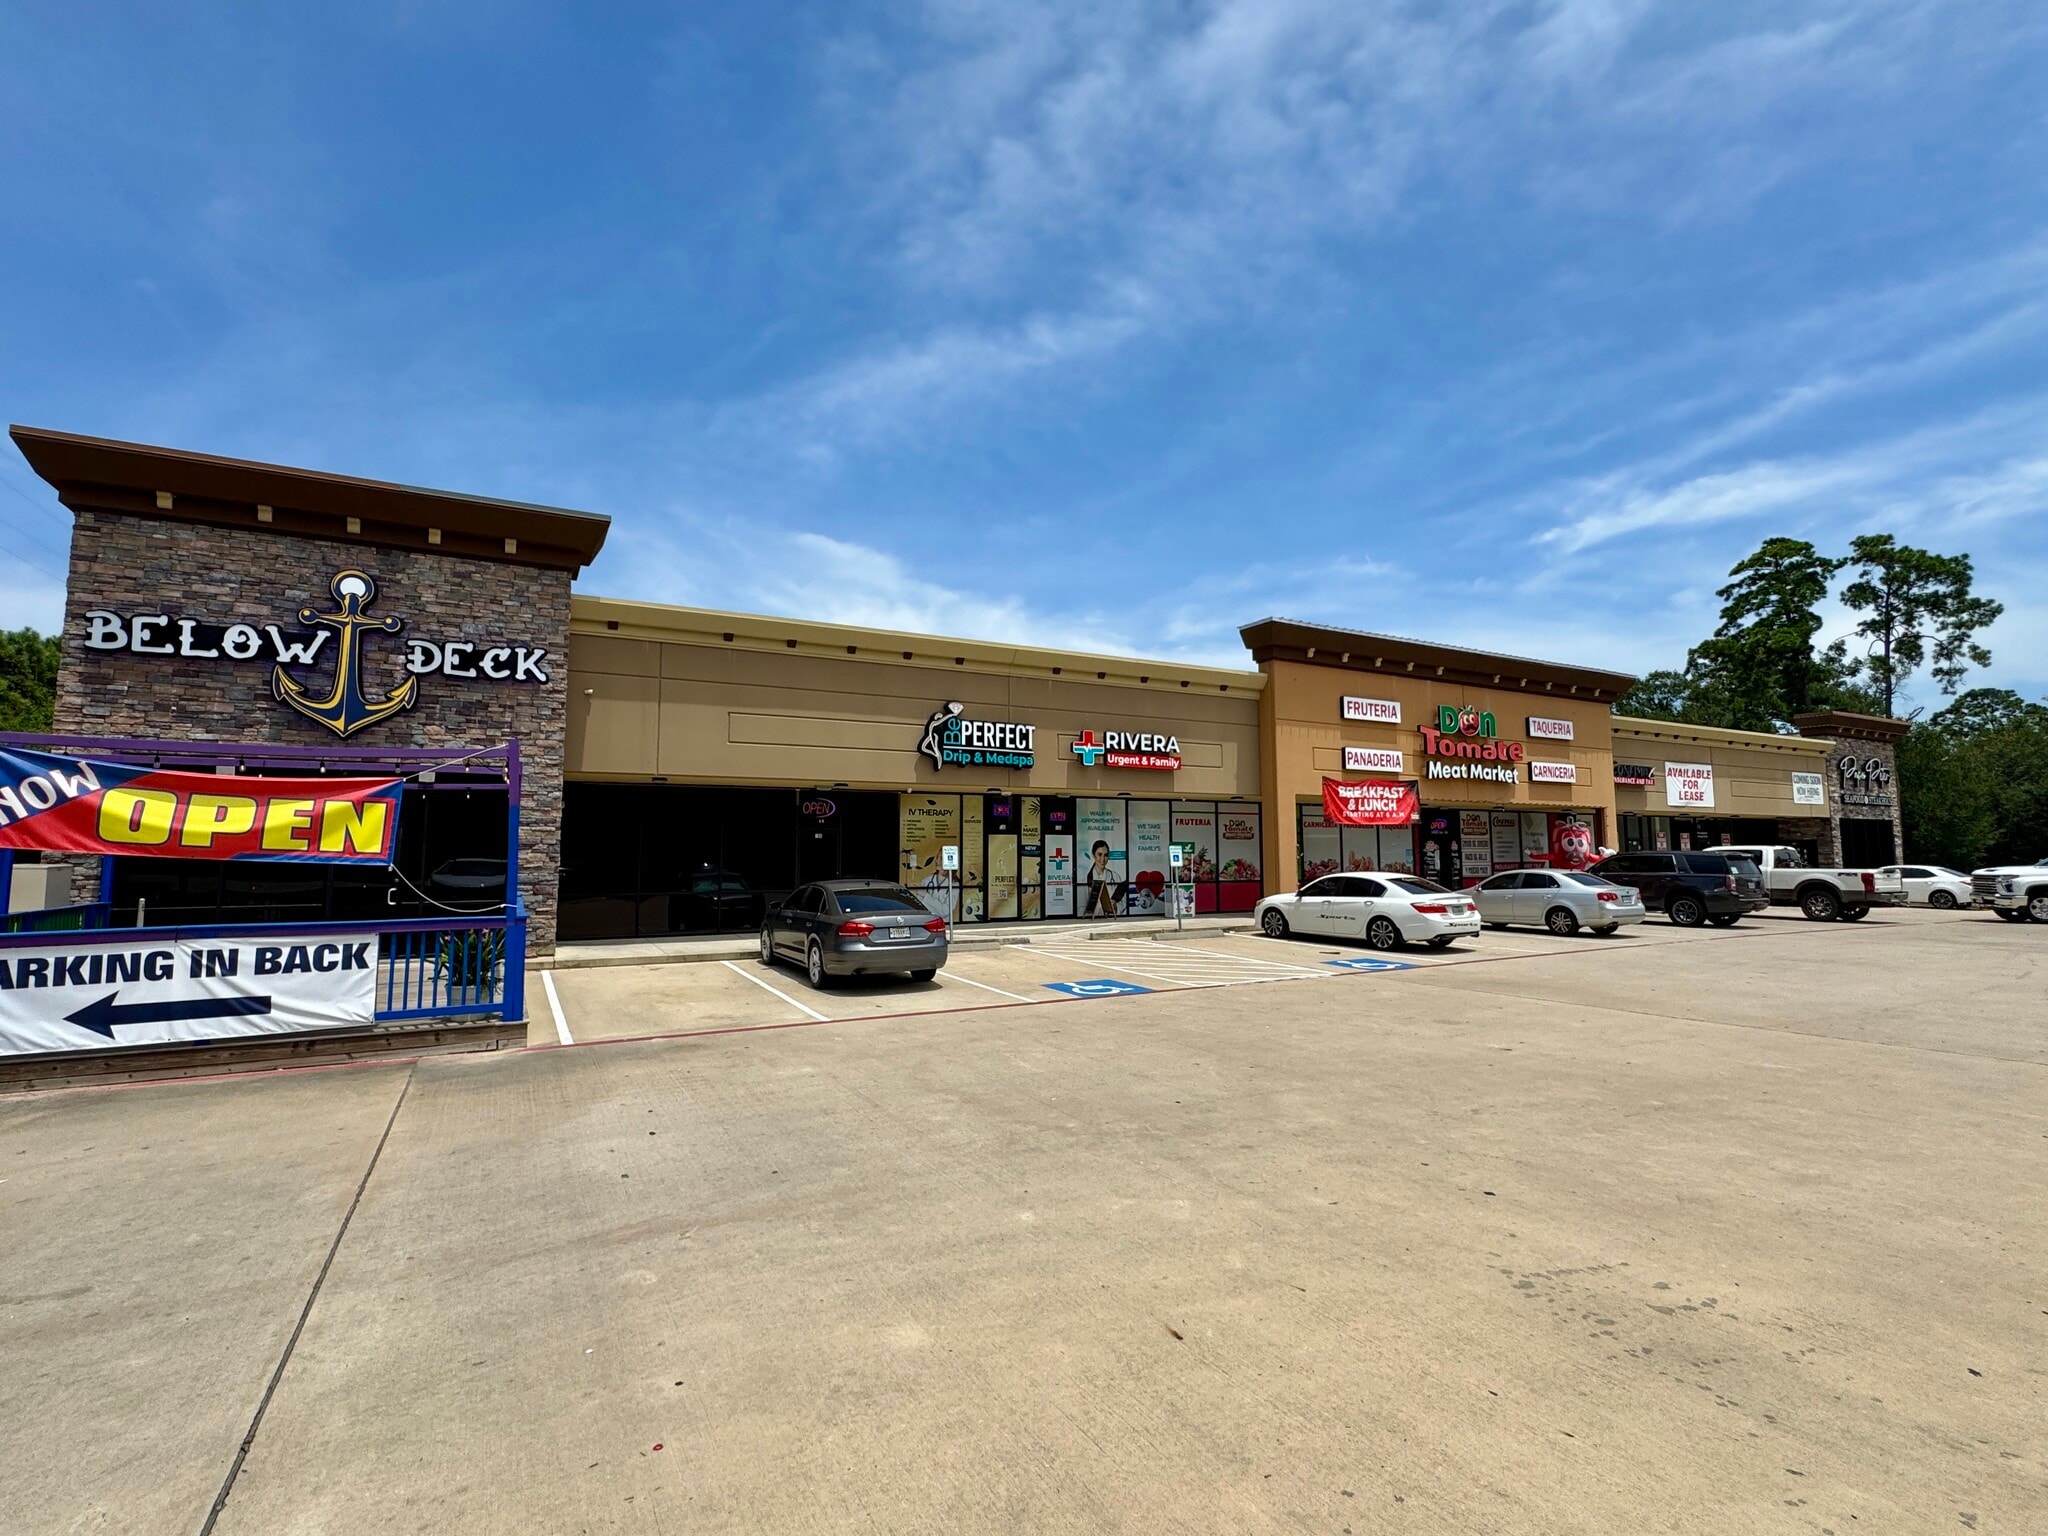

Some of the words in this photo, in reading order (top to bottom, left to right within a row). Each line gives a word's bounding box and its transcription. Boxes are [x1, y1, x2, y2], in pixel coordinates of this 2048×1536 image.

[84, 610, 331, 665] BELOW
[406, 638, 549, 684] DECK
[1347, 701, 1398, 719] FRUTERIA
[1438, 704, 1496, 737] Don
[1532, 720, 1571, 736] TAQUERIA
[943, 718, 961, 745] Be
[961, 720, 1036, 750] PERFECT
[1106, 731, 1181, 753] RIVERA
[1419, 725, 1524, 761] Tomate
[943, 750, 971, 765] Drip
[974, 752, 983, 763] &
[986, 752, 1034, 768] Medspa
[1107, 754, 1139, 766] Urgent
[1141, 757, 1148, 765] &
[1150, 757, 1180, 769] Family
[1347, 751, 1402, 769] PANADERIA
[1428, 760, 1468, 779] Meat
[1470, 763, 1519, 784] Market
[1533, 765, 1575, 779] CARNICERIA
[1667, 767, 1711, 779] AVAILABLE
[0, 761, 101, 826] NOW
[1338, 786, 1405, 799] BREAKFAST
[1683, 780, 1699, 789] FOR
[1347, 799, 1356, 811] &
[1358, 799, 1397, 811] LUNCH
[1678, 791, 1704, 801] LEASE
[803, 801, 830, 814] OPEN
[908, 808, 917, 816] IV
[917, 808, 953, 817] THERAPY
[97, 788, 389, 854] OPEN
[1175, 818, 1211, 827] FRUTERIA
[1223, 824, 1254, 832] Tomate
[0, 950, 175, 990] ARKING
[189, 948, 239, 979] IN
[254, 942, 371, 976] BACK
